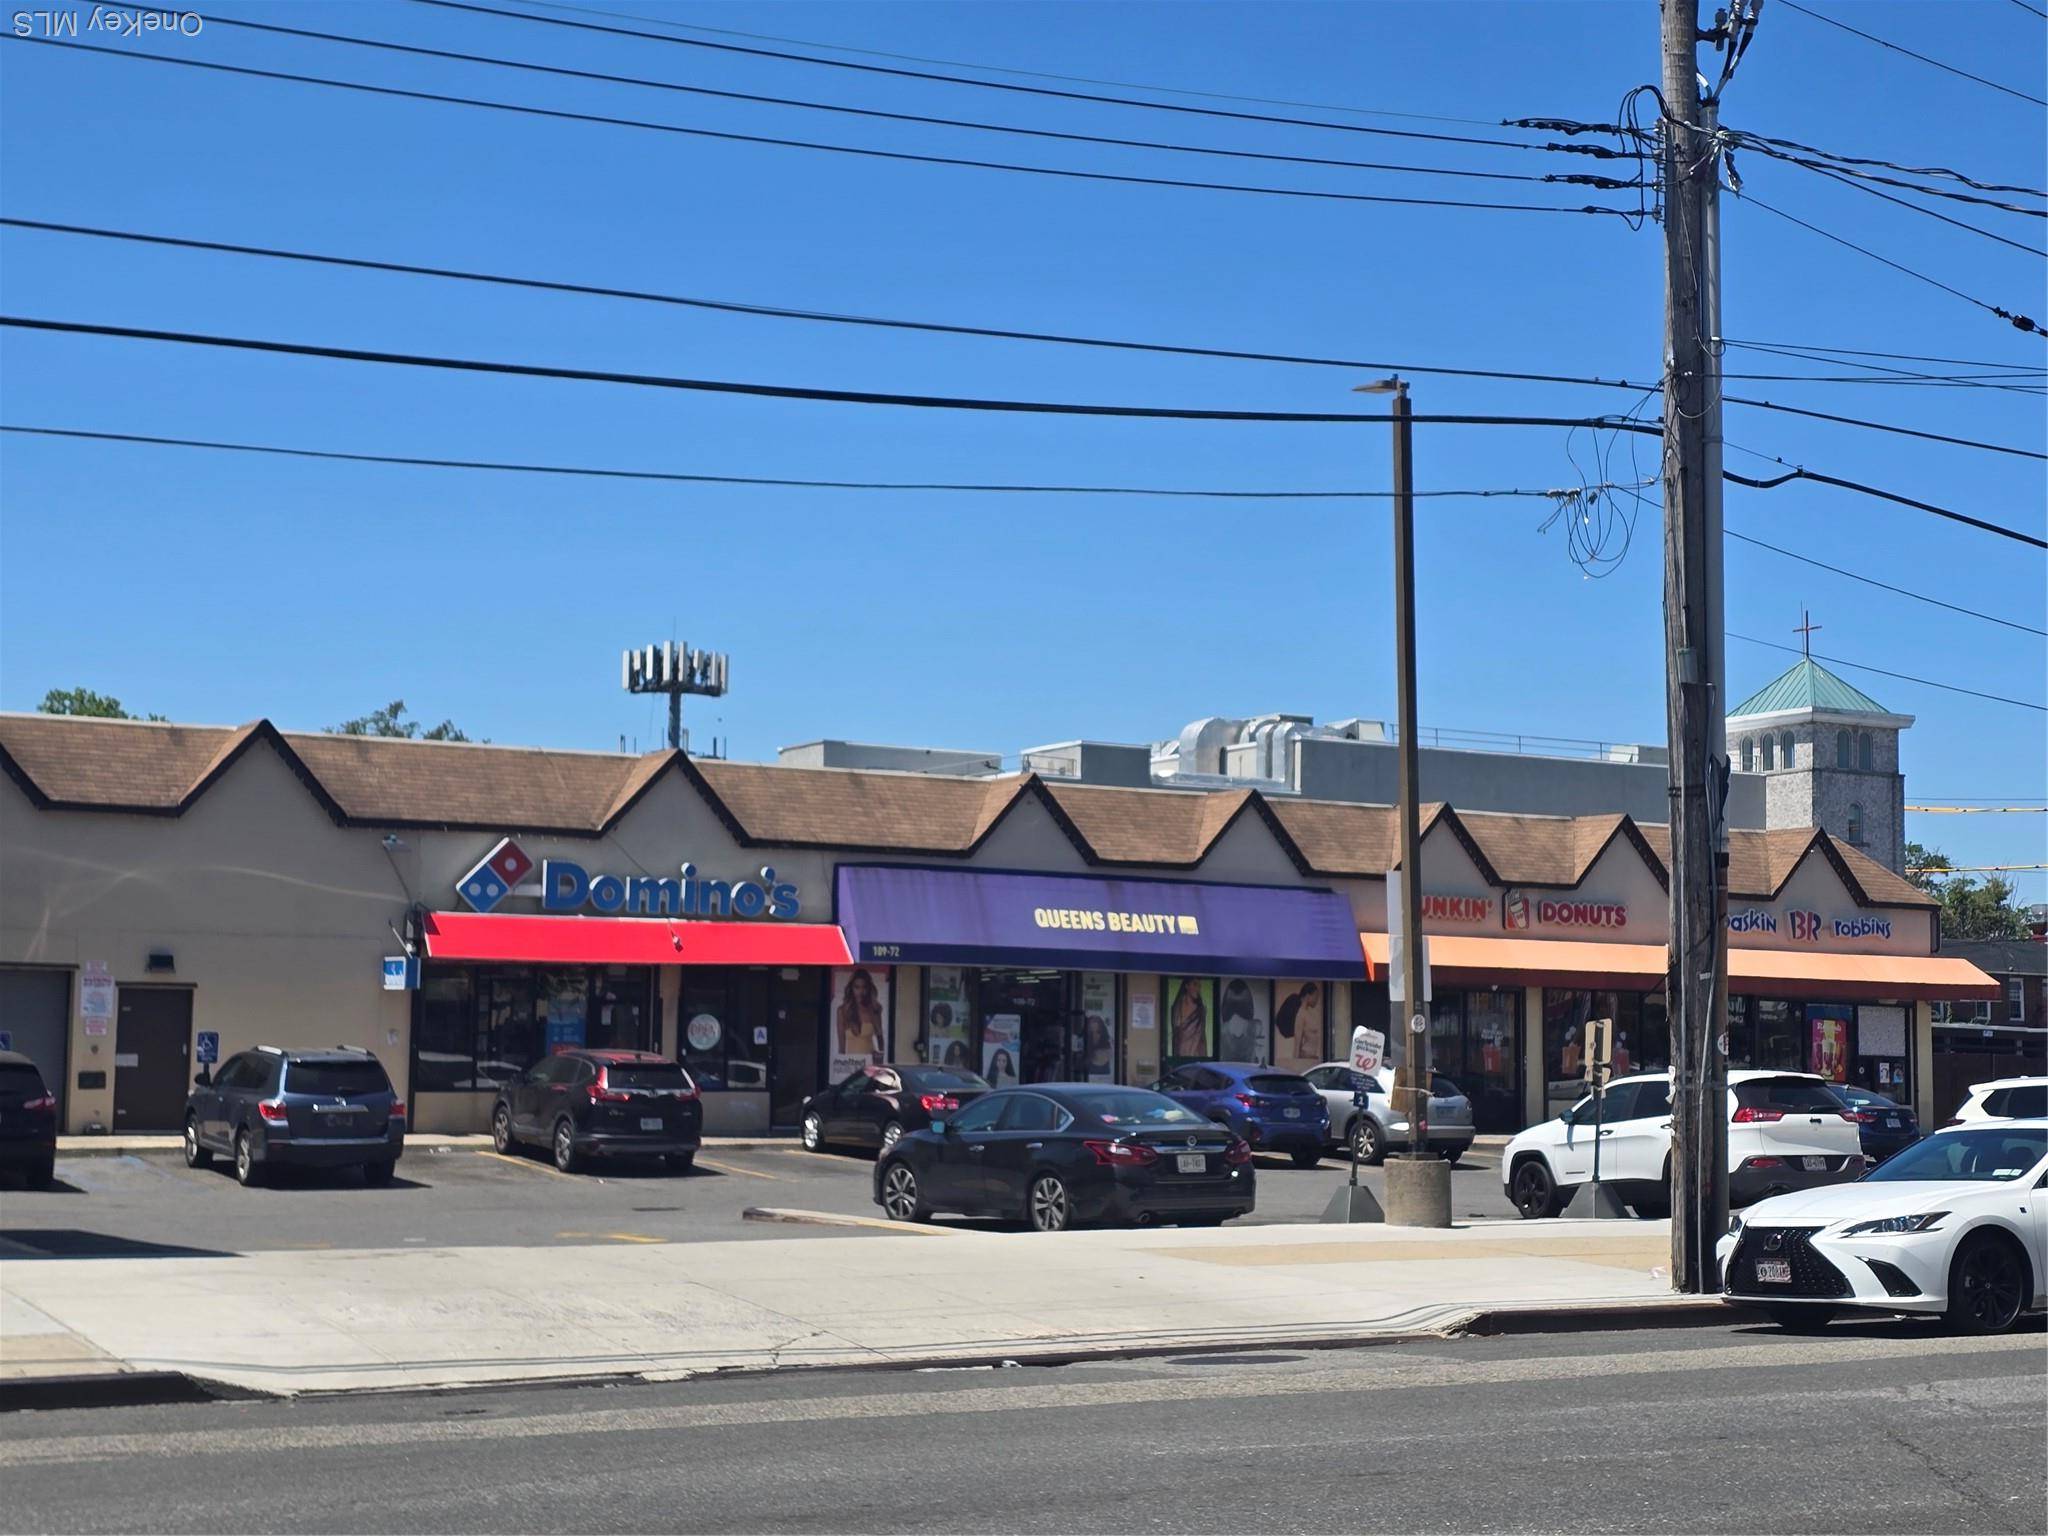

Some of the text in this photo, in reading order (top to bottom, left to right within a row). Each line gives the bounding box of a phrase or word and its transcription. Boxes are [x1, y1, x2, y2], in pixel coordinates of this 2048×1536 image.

[542, 859, 799, 918] Domino's
[1034, 908, 1176, 934] QUEENS BEAUTY
[1421, 896, 1627, 926] UNKIN' DONUTS
[1789, 910, 1822, 941] BR
[756, 1029, 765, 1040] A
